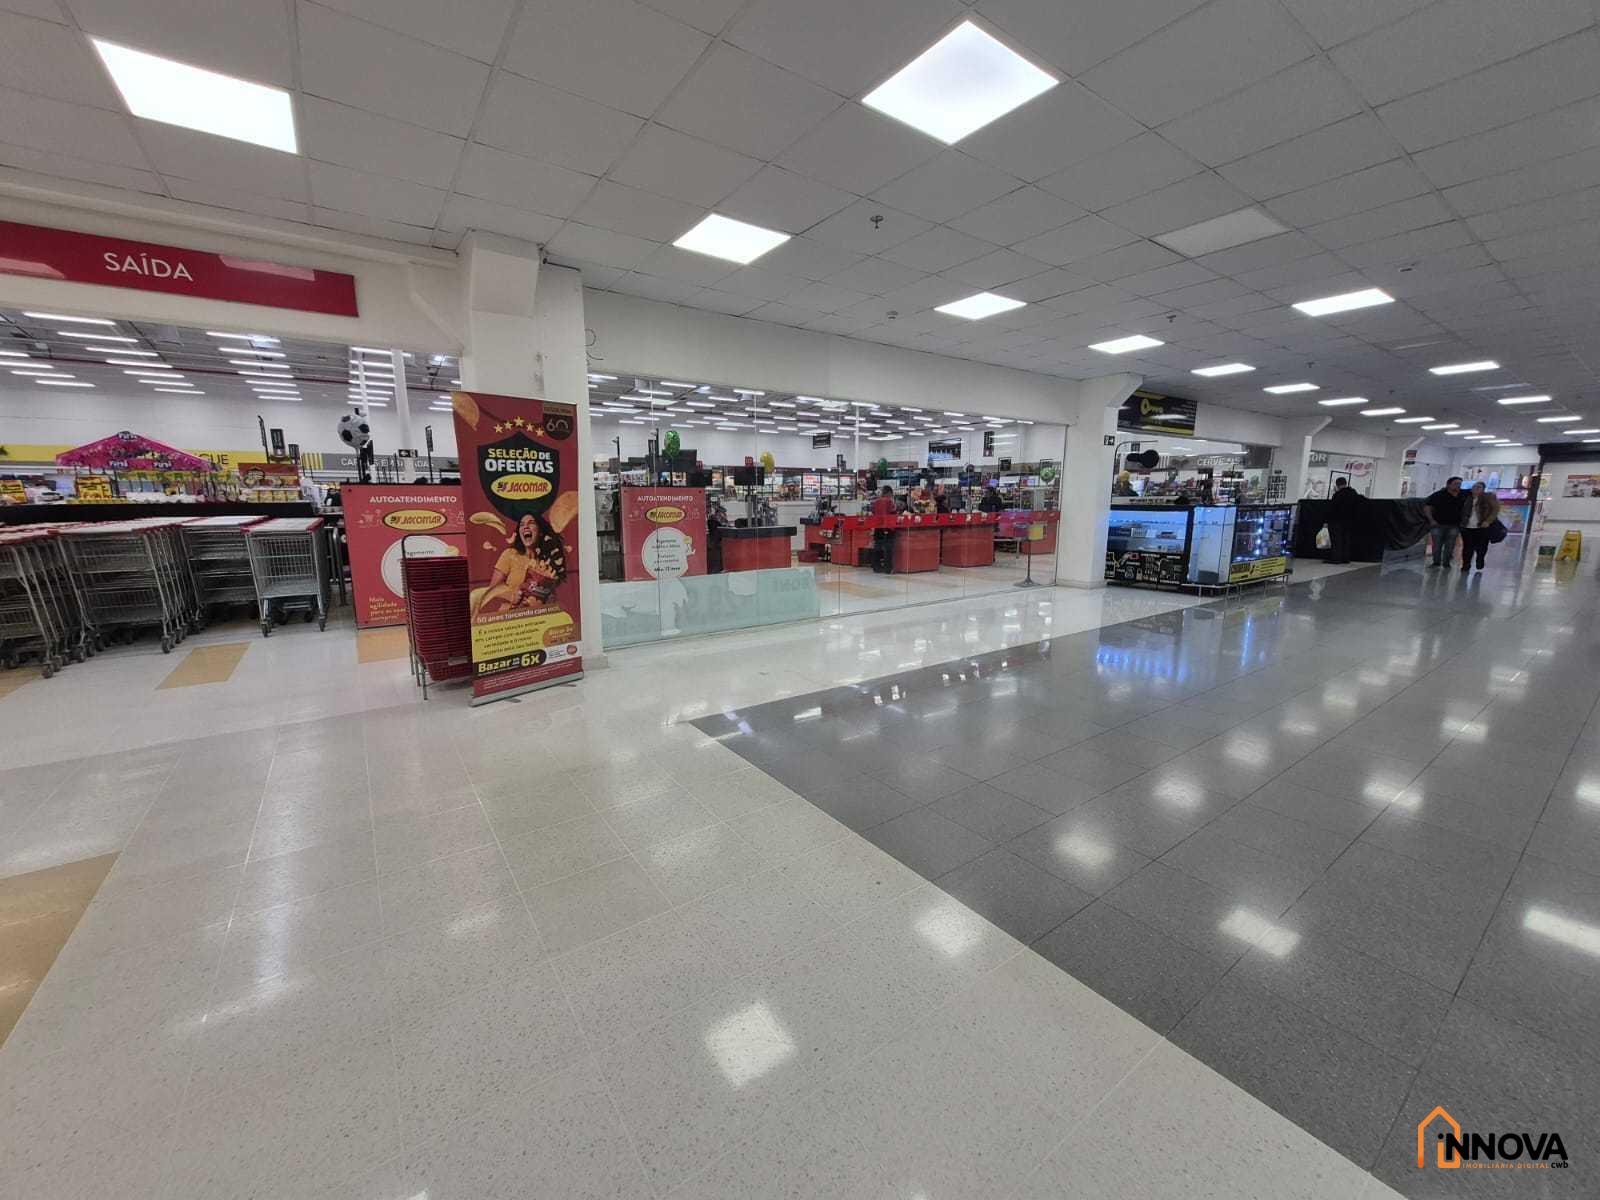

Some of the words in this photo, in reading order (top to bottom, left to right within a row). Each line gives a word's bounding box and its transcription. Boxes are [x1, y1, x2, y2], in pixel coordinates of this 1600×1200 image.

[103, 252, 194, 282] SAÍDA
[487, 447, 538, 460] SELEÇÃO
[538, 451, 551, 460] DE
[485, 458, 554, 474] OFERTAS
[369, 495, 457, 504] AUTOATENDIMENTO
[478, 659, 513, 673] Bazar
[521, 653, 541, 667] 6x
